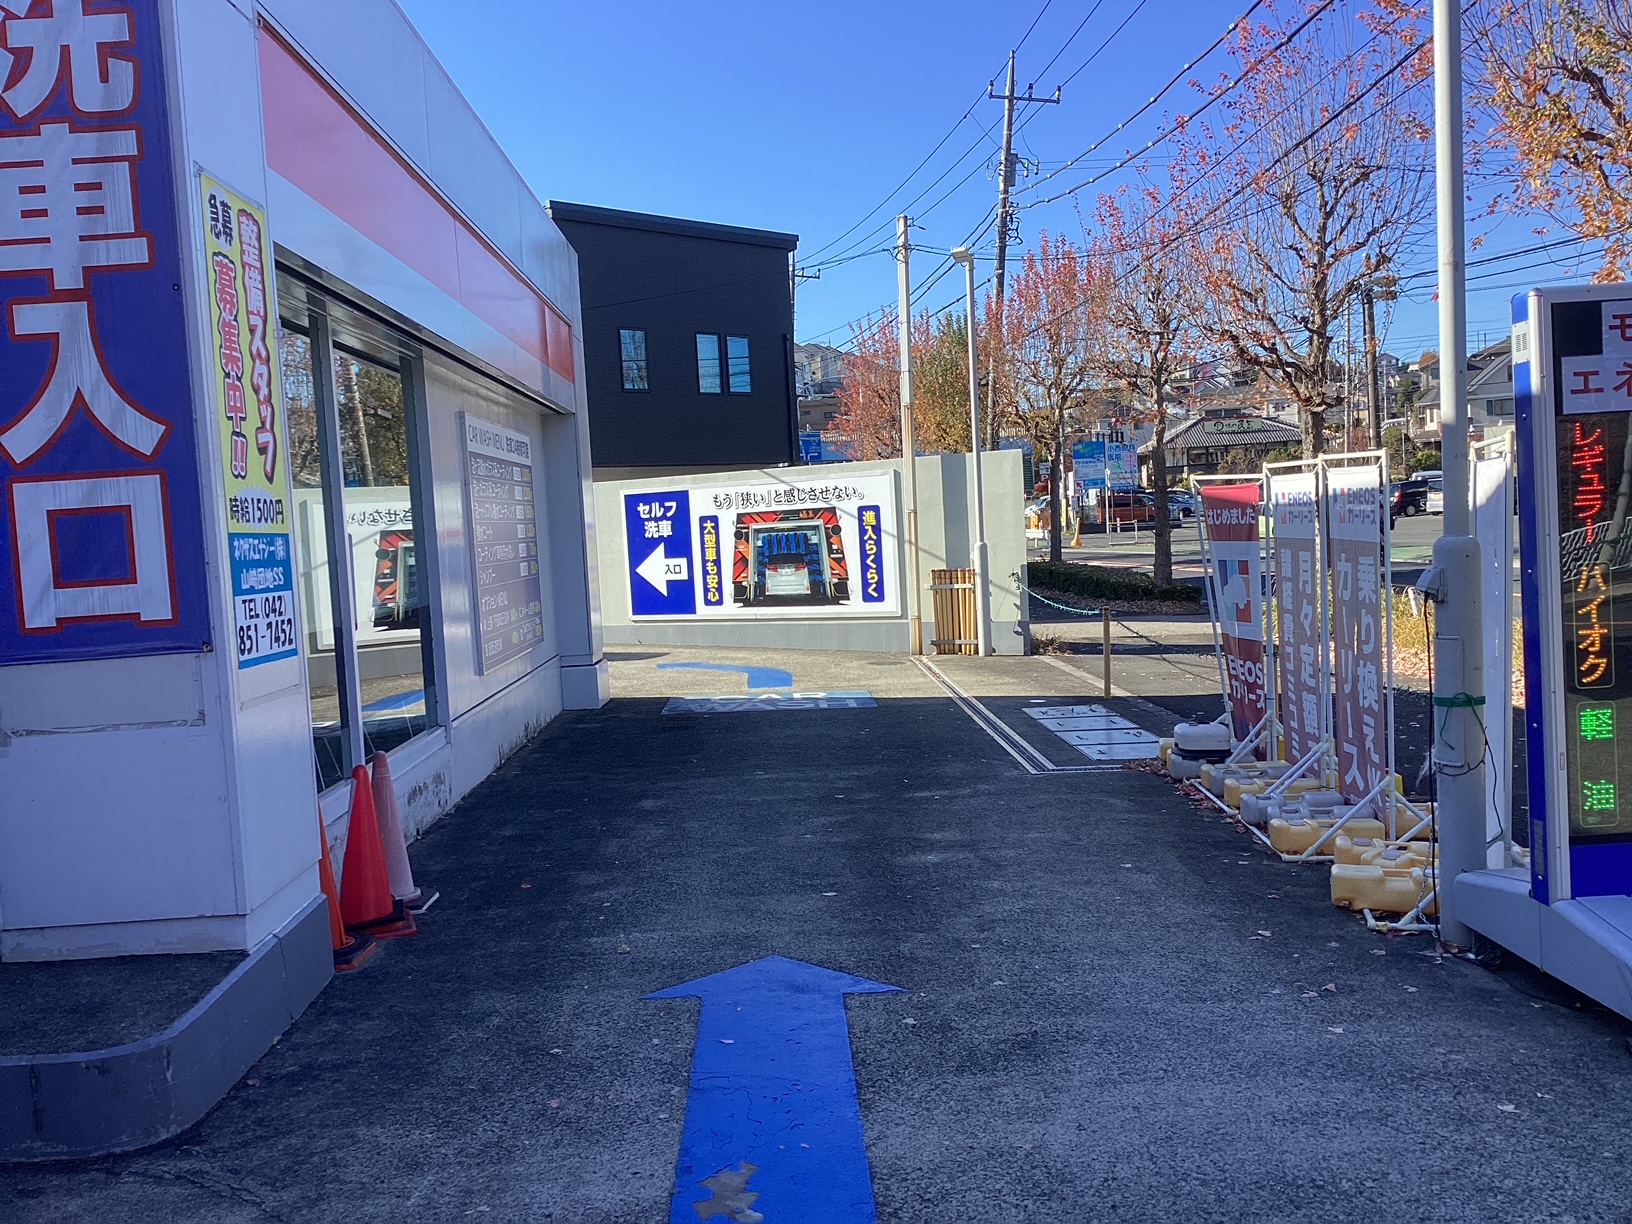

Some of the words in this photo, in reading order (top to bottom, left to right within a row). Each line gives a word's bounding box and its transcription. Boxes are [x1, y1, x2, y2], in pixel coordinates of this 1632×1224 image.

[0, 0, 173, 629] 洗車入口
[238, 211, 276, 482] 整備スタッフ
[1041, 474, 1049, 482] P
[1571, 422, 1605, 544] レギュラー
[712, 485, 865, 510] もう「狭い」と感じさせない。
[1287, 491, 1313, 506] ENEOS
[1347, 487, 1376, 506] ENEOS
[229, 496, 285, 525] 時給1500円
[636, 501, 678, 520] セルフ
[1206, 507, 1256, 525] はじめました
[1287, 509, 1314, 524] カーリース
[1347, 509, 1377, 525] カーリース
[644, 520, 673, 538] 洗車
[703, 520, 720, 602] 大型車も安心
[862, 510, 879, 598] 進入らくらく
[241, 566, 284, 590] 山崎団地SS
[664, 564, 682, 575] 入口
[238, 617, 294, 656] 851-7452
[1577, 565, 1609, 684] ハイオク
[1281, 548, 1301, 761] 諸経費コミコミ
[1227, 654, 1264, 686] EEOS
[1336, 552, 1364, 791] カーリース
[690, 699, 858, 713] WASH
[711, 692, 828, 703] CAR
[1580, 708, 1615, 811] 軽油
